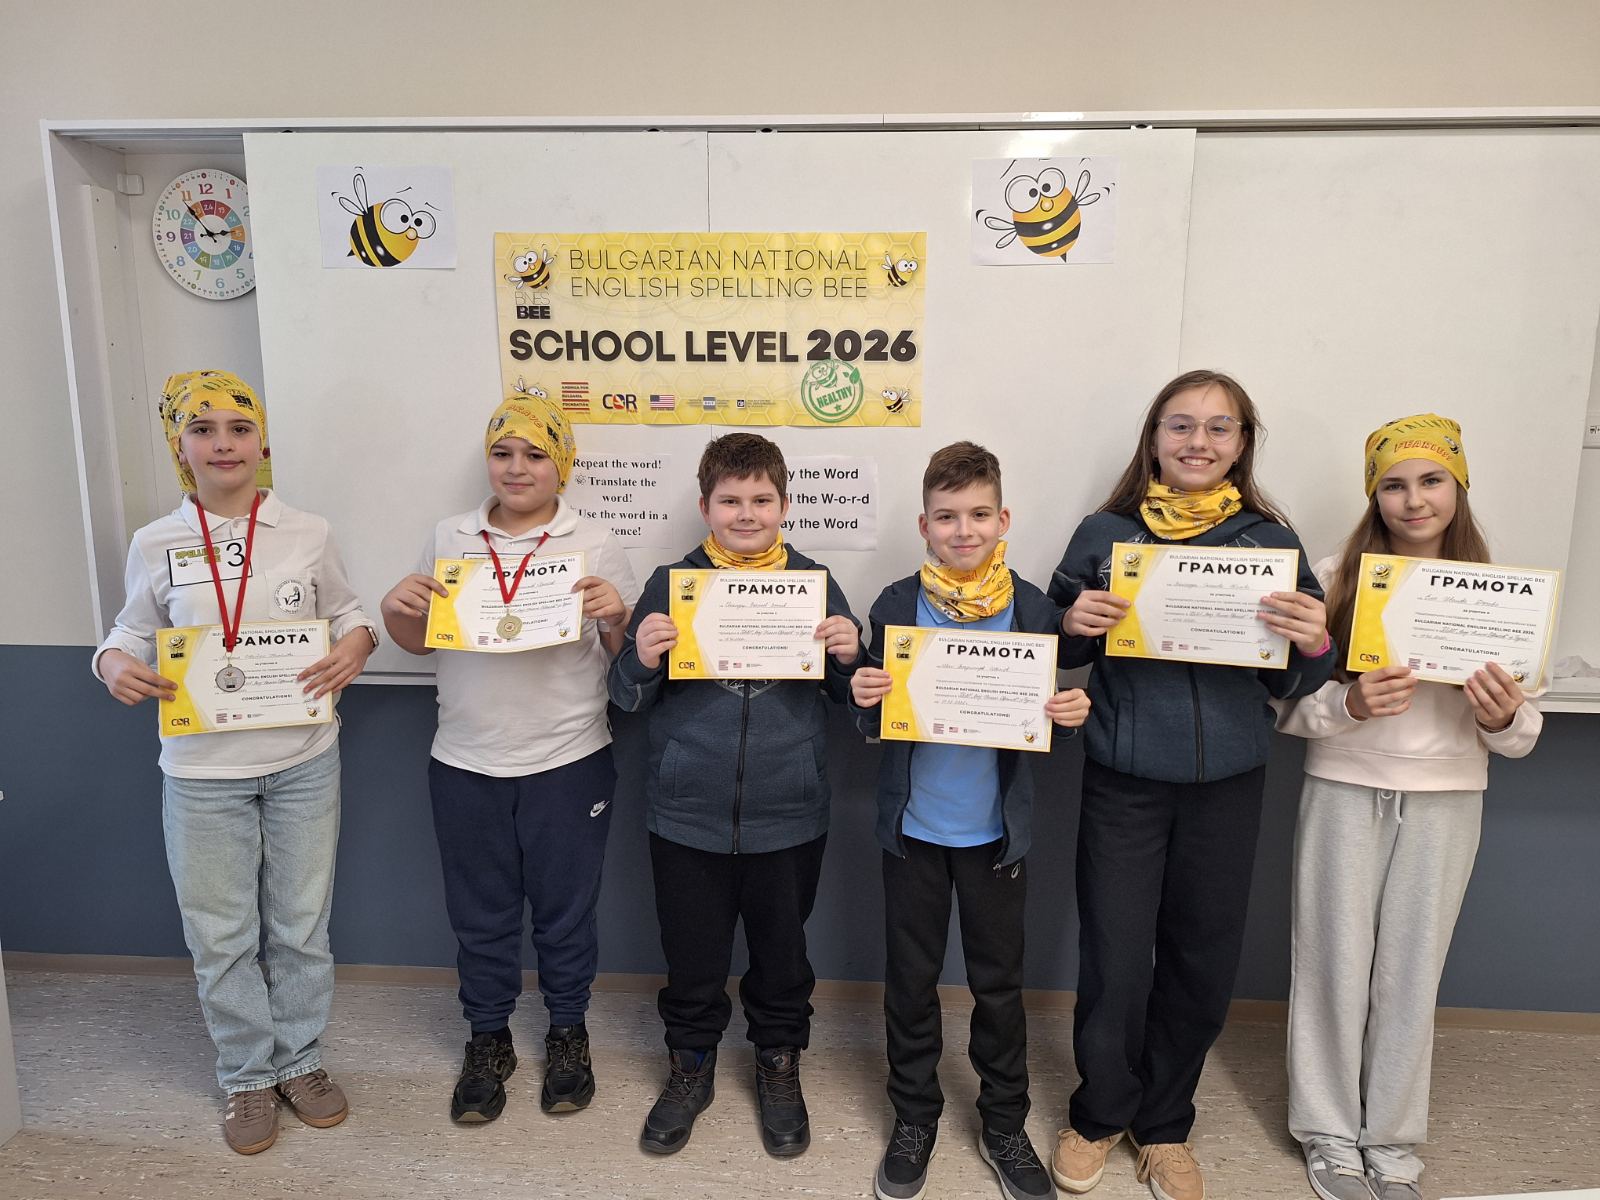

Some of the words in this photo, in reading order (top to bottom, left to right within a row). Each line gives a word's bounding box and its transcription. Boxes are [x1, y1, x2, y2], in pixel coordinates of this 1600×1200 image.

[198, 184, 213, 194] 12
[226, 189, 232, 199] 1
[182, 191, 192, 201] 11
[166, 209, 180, 220] 10
[166, 232, 175, 242] 9
[177, 256, 185, 266] 8
[569, 249, 721, 270] BULGARIAN
[732, 249, 867, 270] NATIONAL
[194, 270, 202, 280] 7
[236, 268, 245, 279] 5
[216, 278, 224, 288] 6
[571, 276, 679, 298] ENGLISH
[690, 276, 812, 298] SPELLING
[824, 277, 867, 298] BEE
[516, 306, 551, 319] BEE
[510, 330, 676, 362] SCHOOL
[685, 330, 799, 362] LEVEL
[806, 329, 918, 362] 2026
[816, 385, 853, 408] HEALTHY
[573, 458, 608, 470] Repeat
[612, 459, 628, 468] the
[631, 460, 662, 469] word!
[800, 469, 820, 479] the
[824, 469, 859, 479] Word
[588, 477, 637, 486] Translate
[640, 478, 656, 487] the
[602, 494, 632, 503] word!
[797, 494, 817, 504] the
[822, 493, 869, 504] W-o-r-d
[579, 509, 597, 518] Use
[600, 510, 616, 519] the
[619, 511, 645, 520] word
[649, 511, 658, 520] in
[780, 521, 795, 531] ay
[800, 519, 820, 528] the
[824, 518, 858, 529] Word
[226, 543, 245, 567] 3
[1179, 562, 1274, 576] ГРАМОТА
[728, 584, 807, 594] ГРАМОТА
[1430, 575, 1533, 595] ГРАМОТА
[947, 644, 1035, 659] ГРАМОТА
